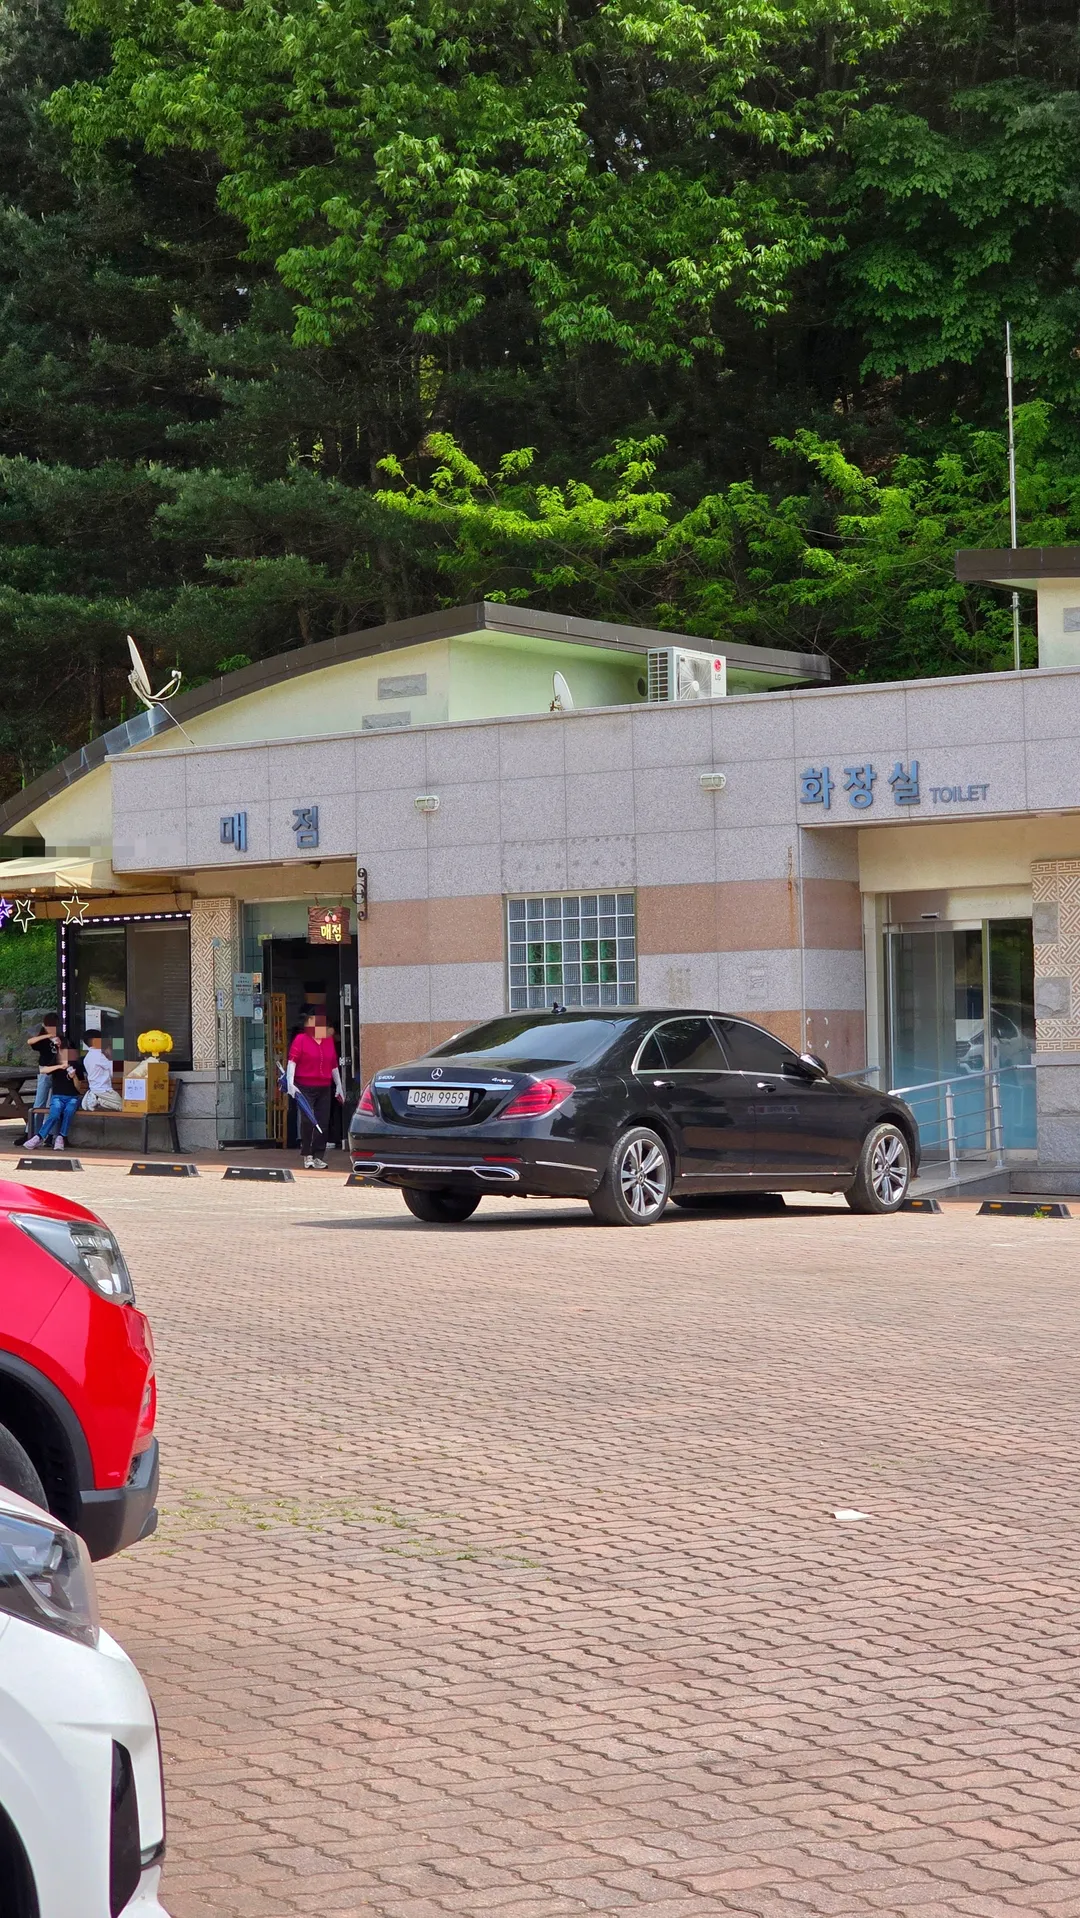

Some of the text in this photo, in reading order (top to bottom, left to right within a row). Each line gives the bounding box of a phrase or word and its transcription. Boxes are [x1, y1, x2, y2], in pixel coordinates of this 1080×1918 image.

[800, 760, 922, 810] 화장실
[928, 783, 990, 804] TOILET
[220, 805, 319, 853] 매점
[438, 1091, 464, 1105] 9959
